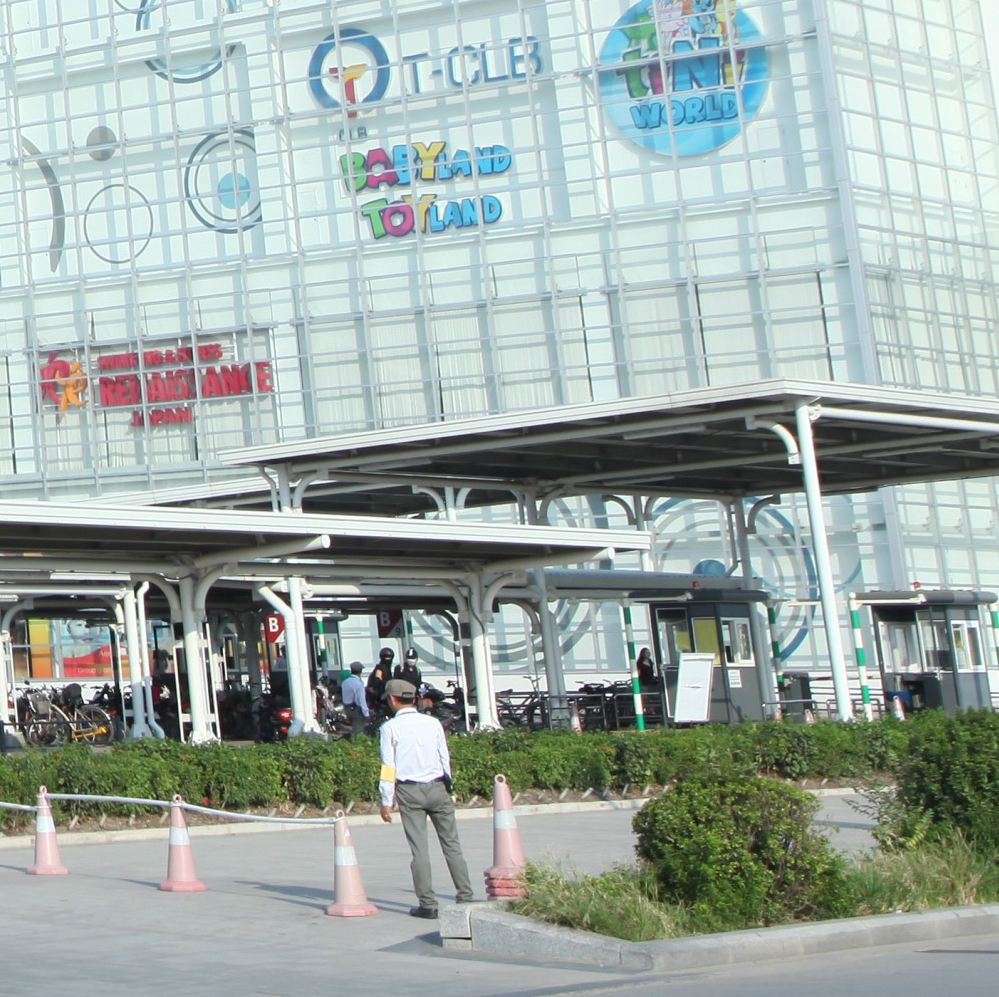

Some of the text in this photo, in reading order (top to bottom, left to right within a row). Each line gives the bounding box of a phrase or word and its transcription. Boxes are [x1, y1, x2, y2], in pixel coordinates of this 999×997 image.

[402, 35, 542, 93] T-CLB
[630, 93, 739, 129] WORLD
[268, 617, 279, 632] B
[380, 611, 391, 627] B
